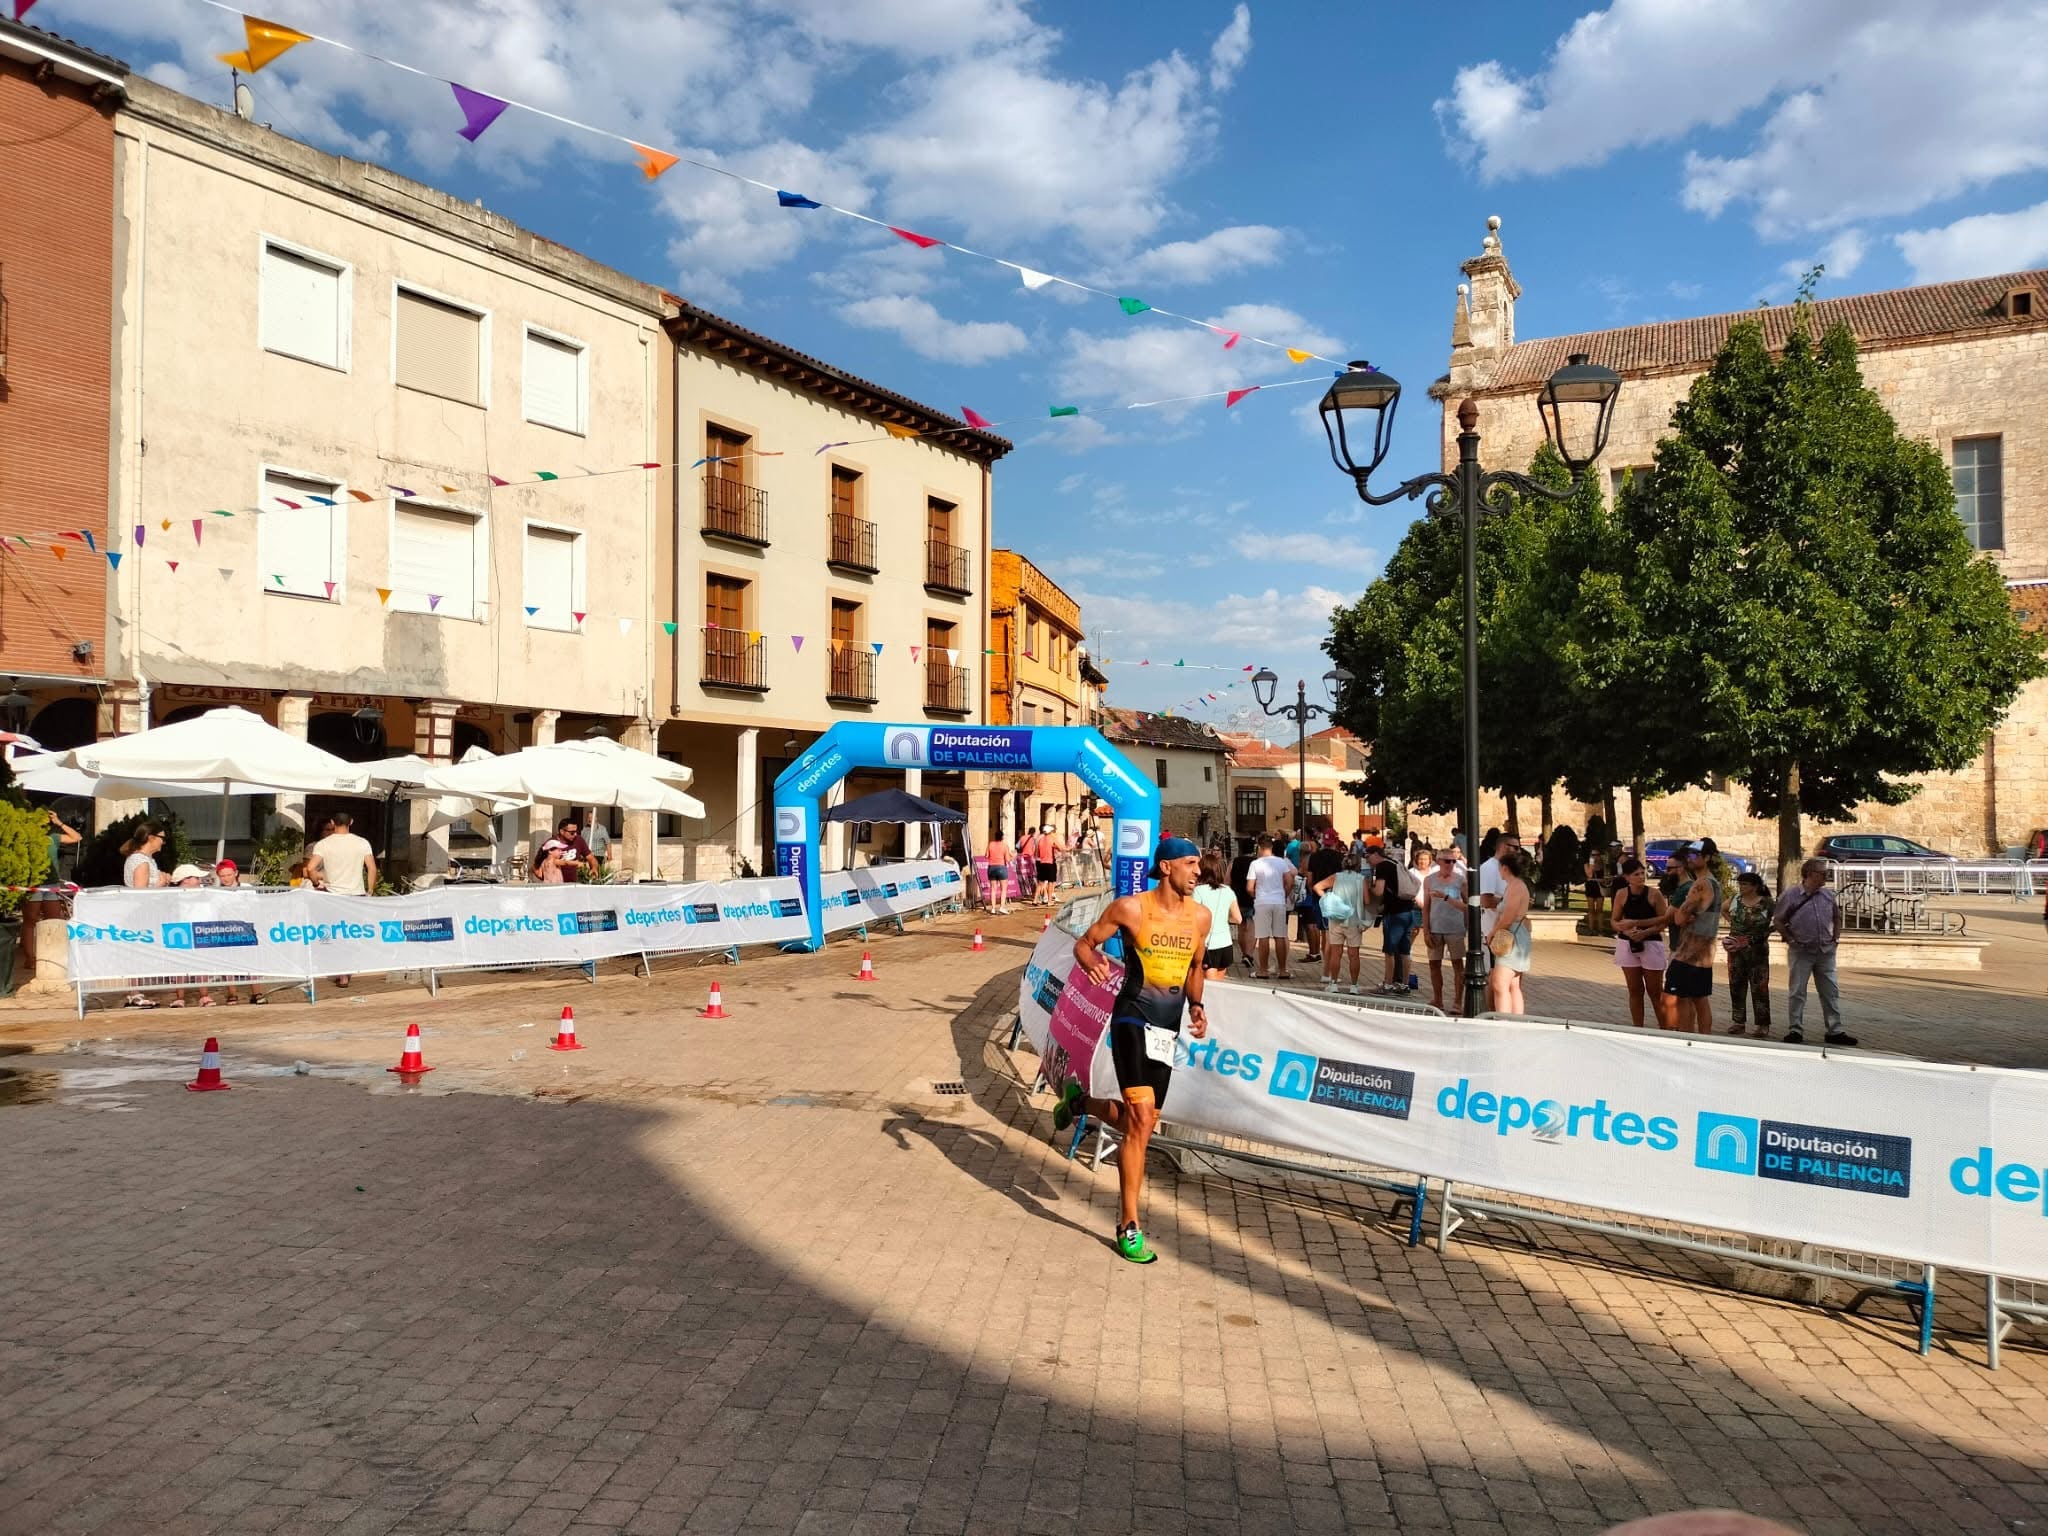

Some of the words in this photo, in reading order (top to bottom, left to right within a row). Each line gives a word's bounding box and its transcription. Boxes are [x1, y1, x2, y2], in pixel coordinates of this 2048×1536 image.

[933, 733, 1011, 748] Diputación
[933, 751, 954, 762] DE
[957, 752, 1030, 764] PALENCIA
[797, 752, 842, 793] deportes
[1078, 761, 1123, 804] deportes
[1120, 861, 1130, 876] DE
[404, 922, 443, 932] Diputación
[464, 915, 554, 937] deportes
[625, 908, 681, 927] deportes
[195, 924, 244, 936] Diputación
[269, 920, 375, 945] deportes
[1150, 931, 1192, 951] GÓMEZ
[1319, 1066, 1392, 1090] Diputación
[1316, 1083, 1336, 1098] DE
[1337, 1086, 1407, 1111] PALENCIA
[1436, 1078, 1679, 1150] deportes
[1766, 1130, 1878, 1160] Diputación
[1764, 1153, 1793, 1171] DE
[1797, 1157, 1905, 1187] PALENCIA
[1949, 1146, 2048, 1217] de
